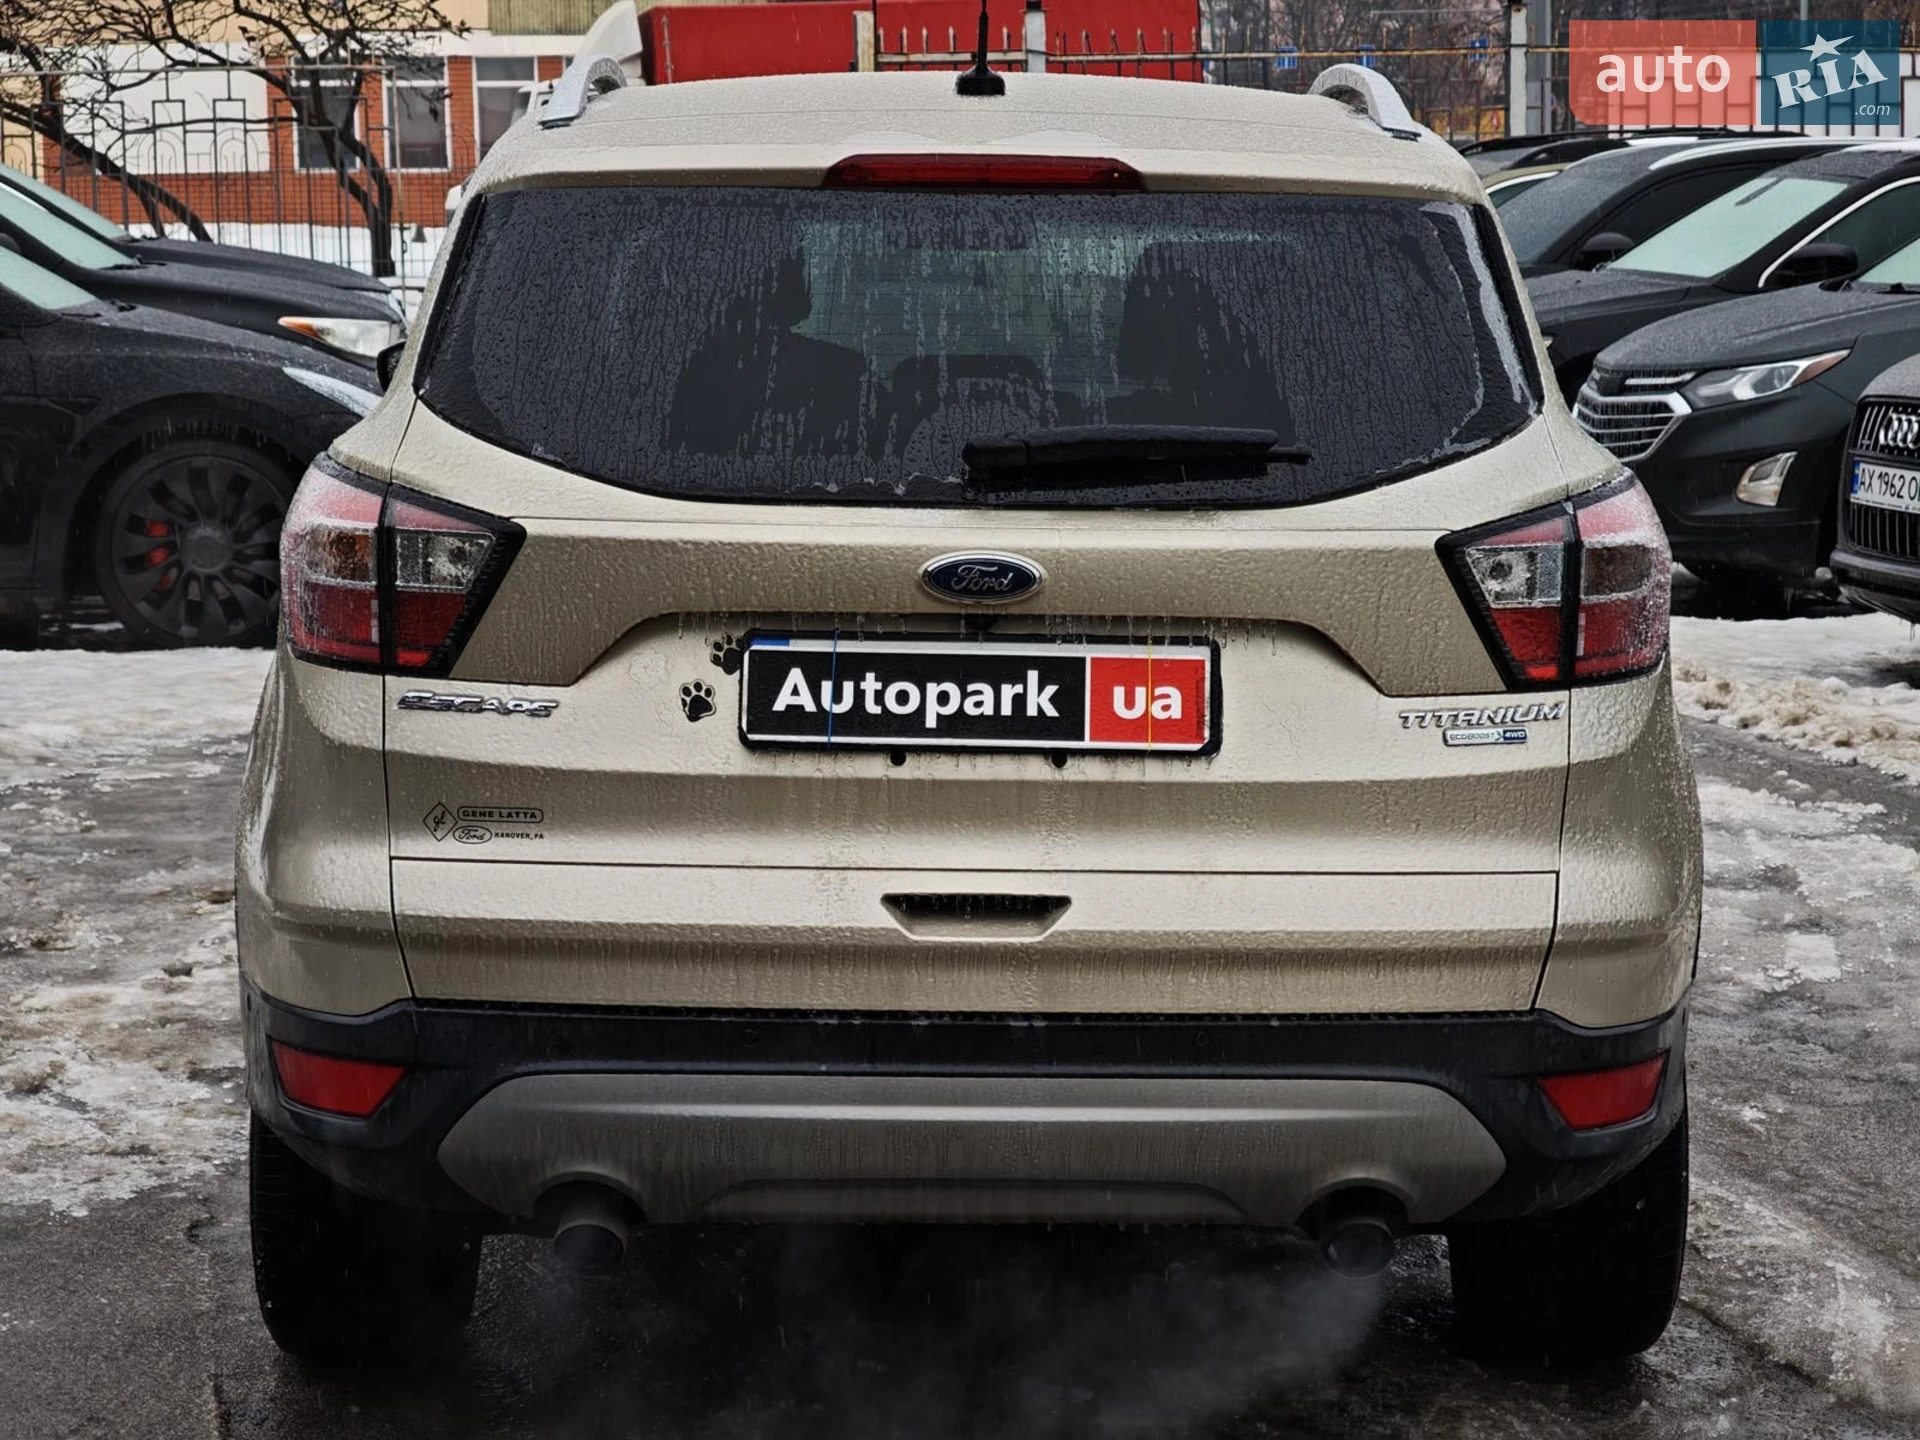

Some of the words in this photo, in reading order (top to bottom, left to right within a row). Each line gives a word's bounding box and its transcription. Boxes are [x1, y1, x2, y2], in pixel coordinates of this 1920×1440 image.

[1860, 467, 1875, 494] AX
[1877, 471, 1906, 499] 1962
[1908, 476, 1920, 502] O
[951, 564, 1013, 591] Ford
[772, 667, 1060, 728] Autopark
[1112, 685, 1182, 719] ua
[1399, 701, 1566, 729] TITANIUM
[1504, 731, 1526, 739] 4WD
[462, 810, 494, 818] GENE
[498, 811, 537, 819] LATTA
[458, 828, 487, 841] Ford
